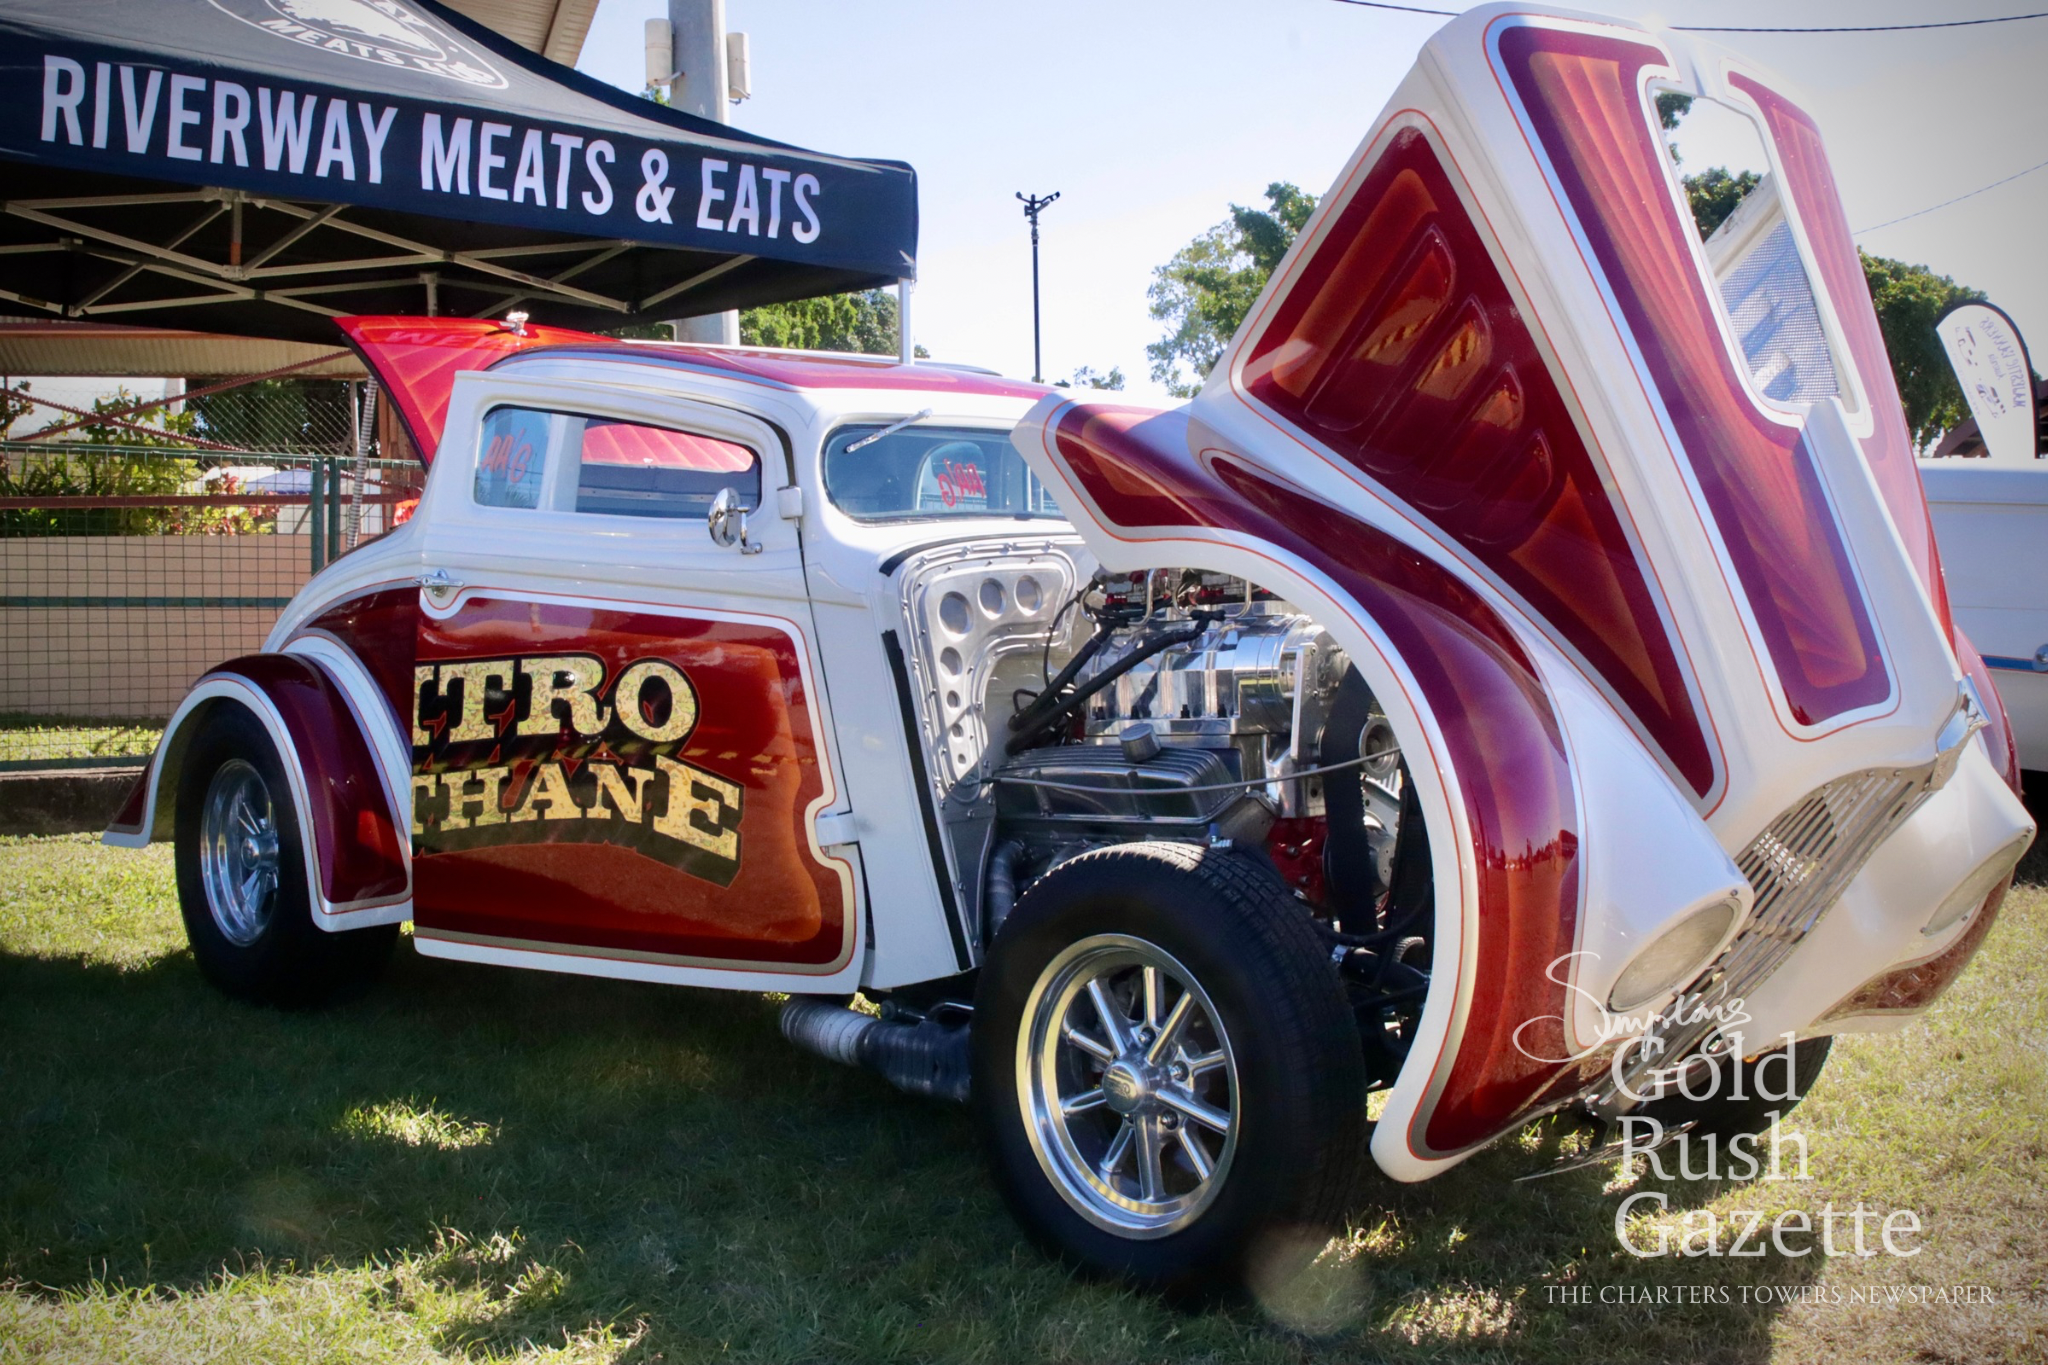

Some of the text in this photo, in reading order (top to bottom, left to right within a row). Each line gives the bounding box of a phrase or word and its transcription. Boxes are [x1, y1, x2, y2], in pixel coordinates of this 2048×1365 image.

[258, 18, 405, 66] MEATS
[41, 54, 822, 245] RIVERWAY MEATS & EATS
